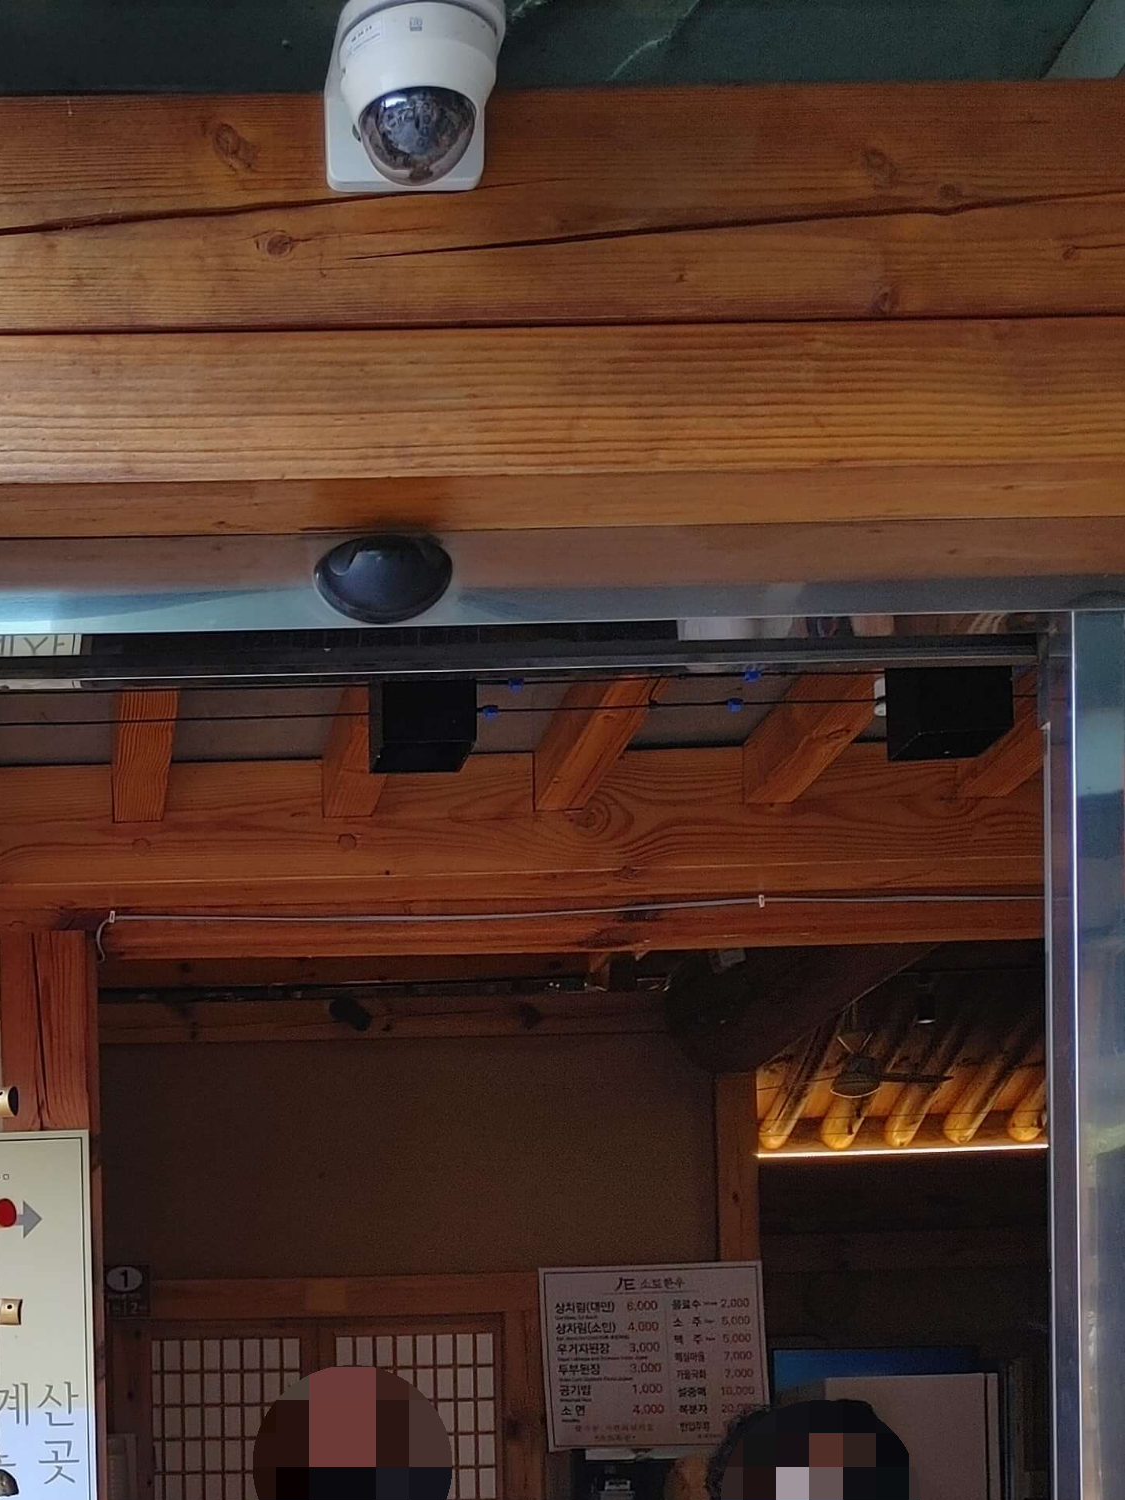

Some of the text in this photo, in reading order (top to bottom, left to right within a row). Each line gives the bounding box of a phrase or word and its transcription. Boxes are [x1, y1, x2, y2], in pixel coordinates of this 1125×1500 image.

[627, 1300, 658, 1311] 6,000
[720, 1298, 750, 1309] 2,000
[628, 1321, 659, 1332] 4,000
[630, 1341, 660, 1353] 3,000
[724, 1351, 753, 1361] 7,000
[630, 1362, 662, 1374] 3,000
[559, 1384, 663, 1396] 공기밥 1,000
[633, 1403, 665, 1415] 4,000
[37, 1438, 80, 1486] 곳
